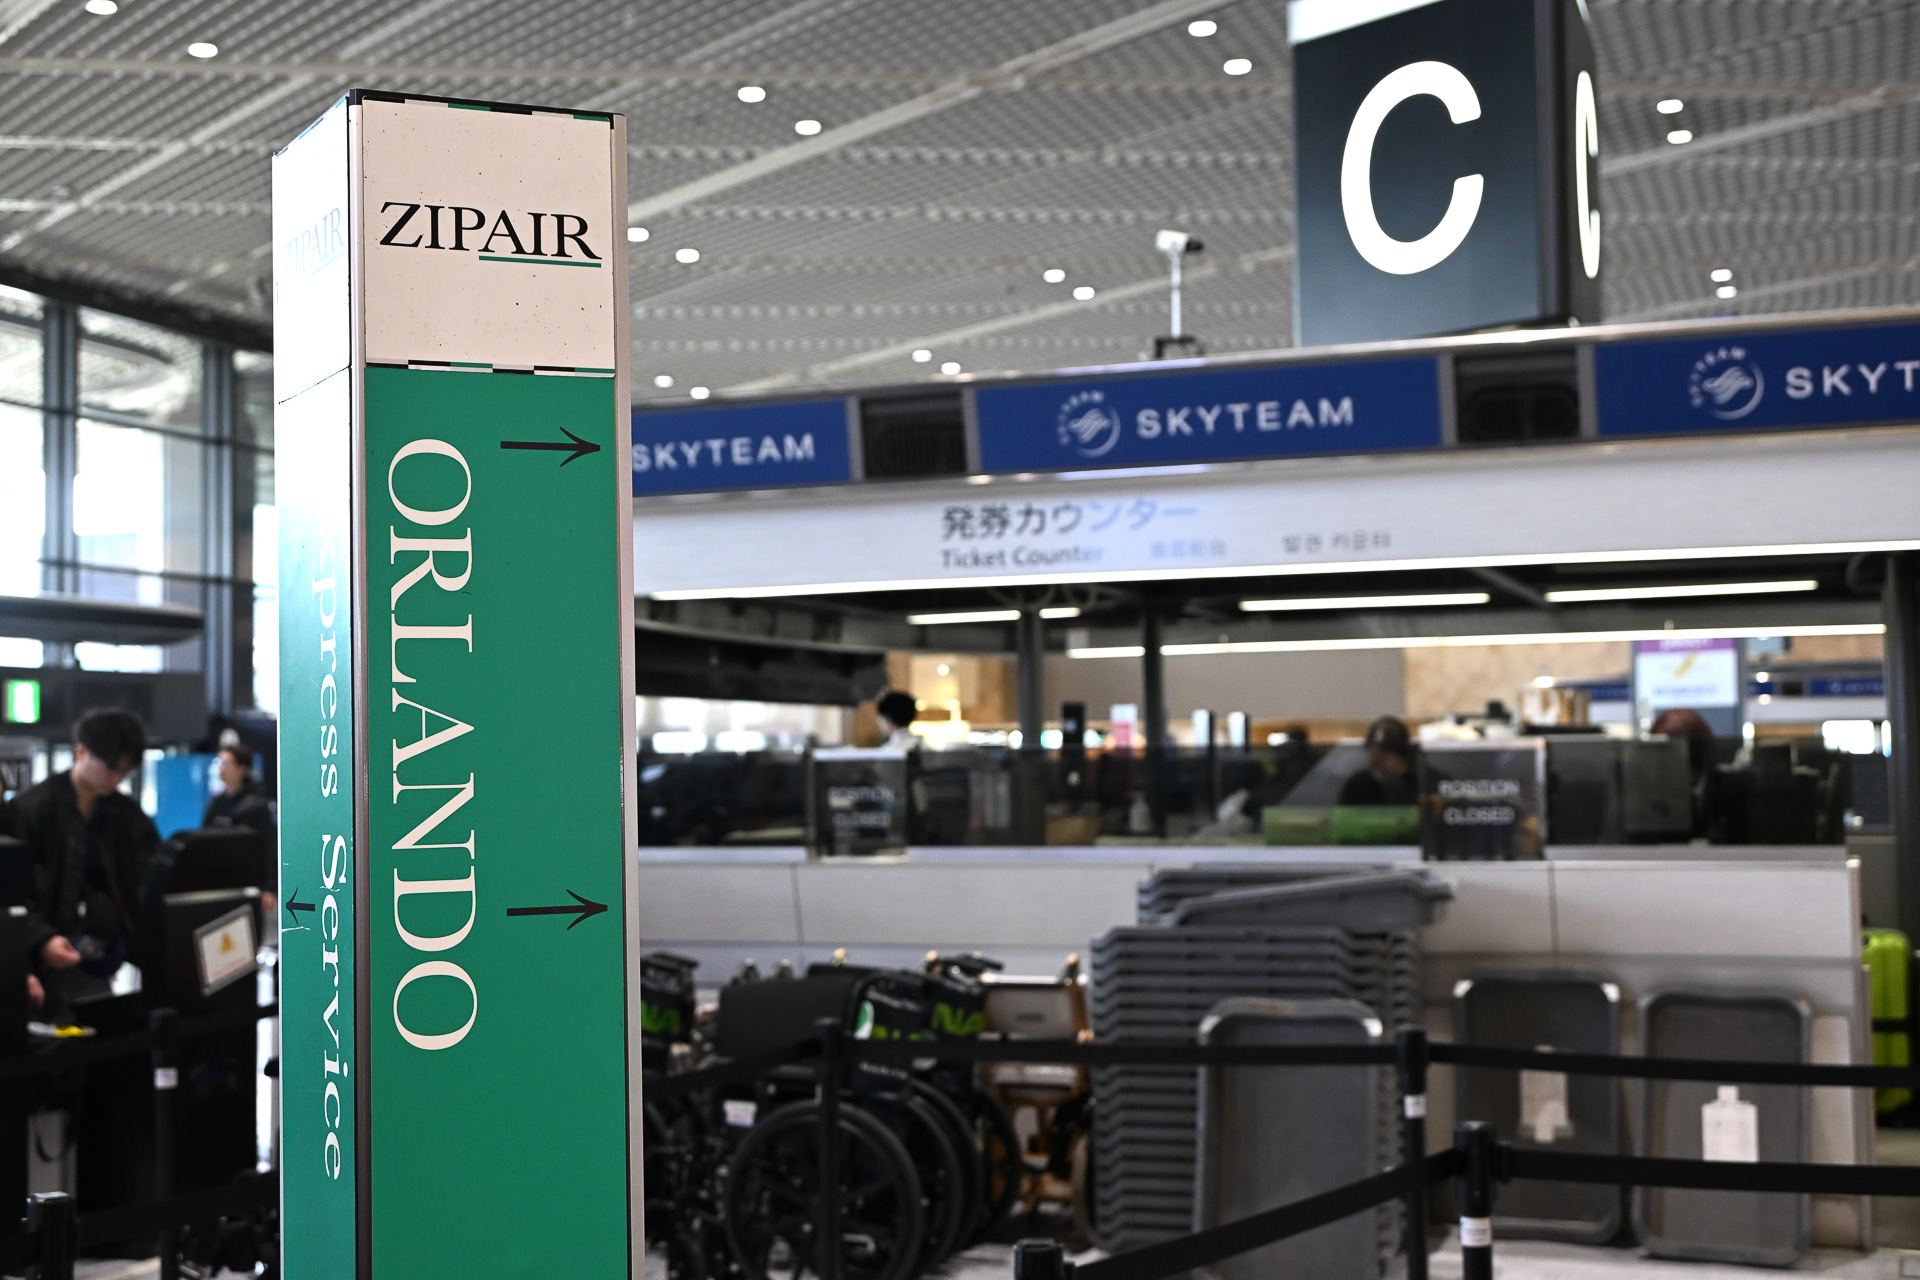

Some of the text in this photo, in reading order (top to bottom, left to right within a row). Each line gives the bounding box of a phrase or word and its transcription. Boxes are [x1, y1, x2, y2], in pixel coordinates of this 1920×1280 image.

[1341, 61, 1484, 276] C
[379, 200, 603, 261] ZIPAIR
[1135, 395, 1355, 441] SKYTEAM
[631, 431, 816, 473] SKYTEAM
[941, 542, 1104, 570] Ticket Counter
[388, 438, 478, 1051] ORLANDO
[311, 520, 349, 1180] xpress Service
